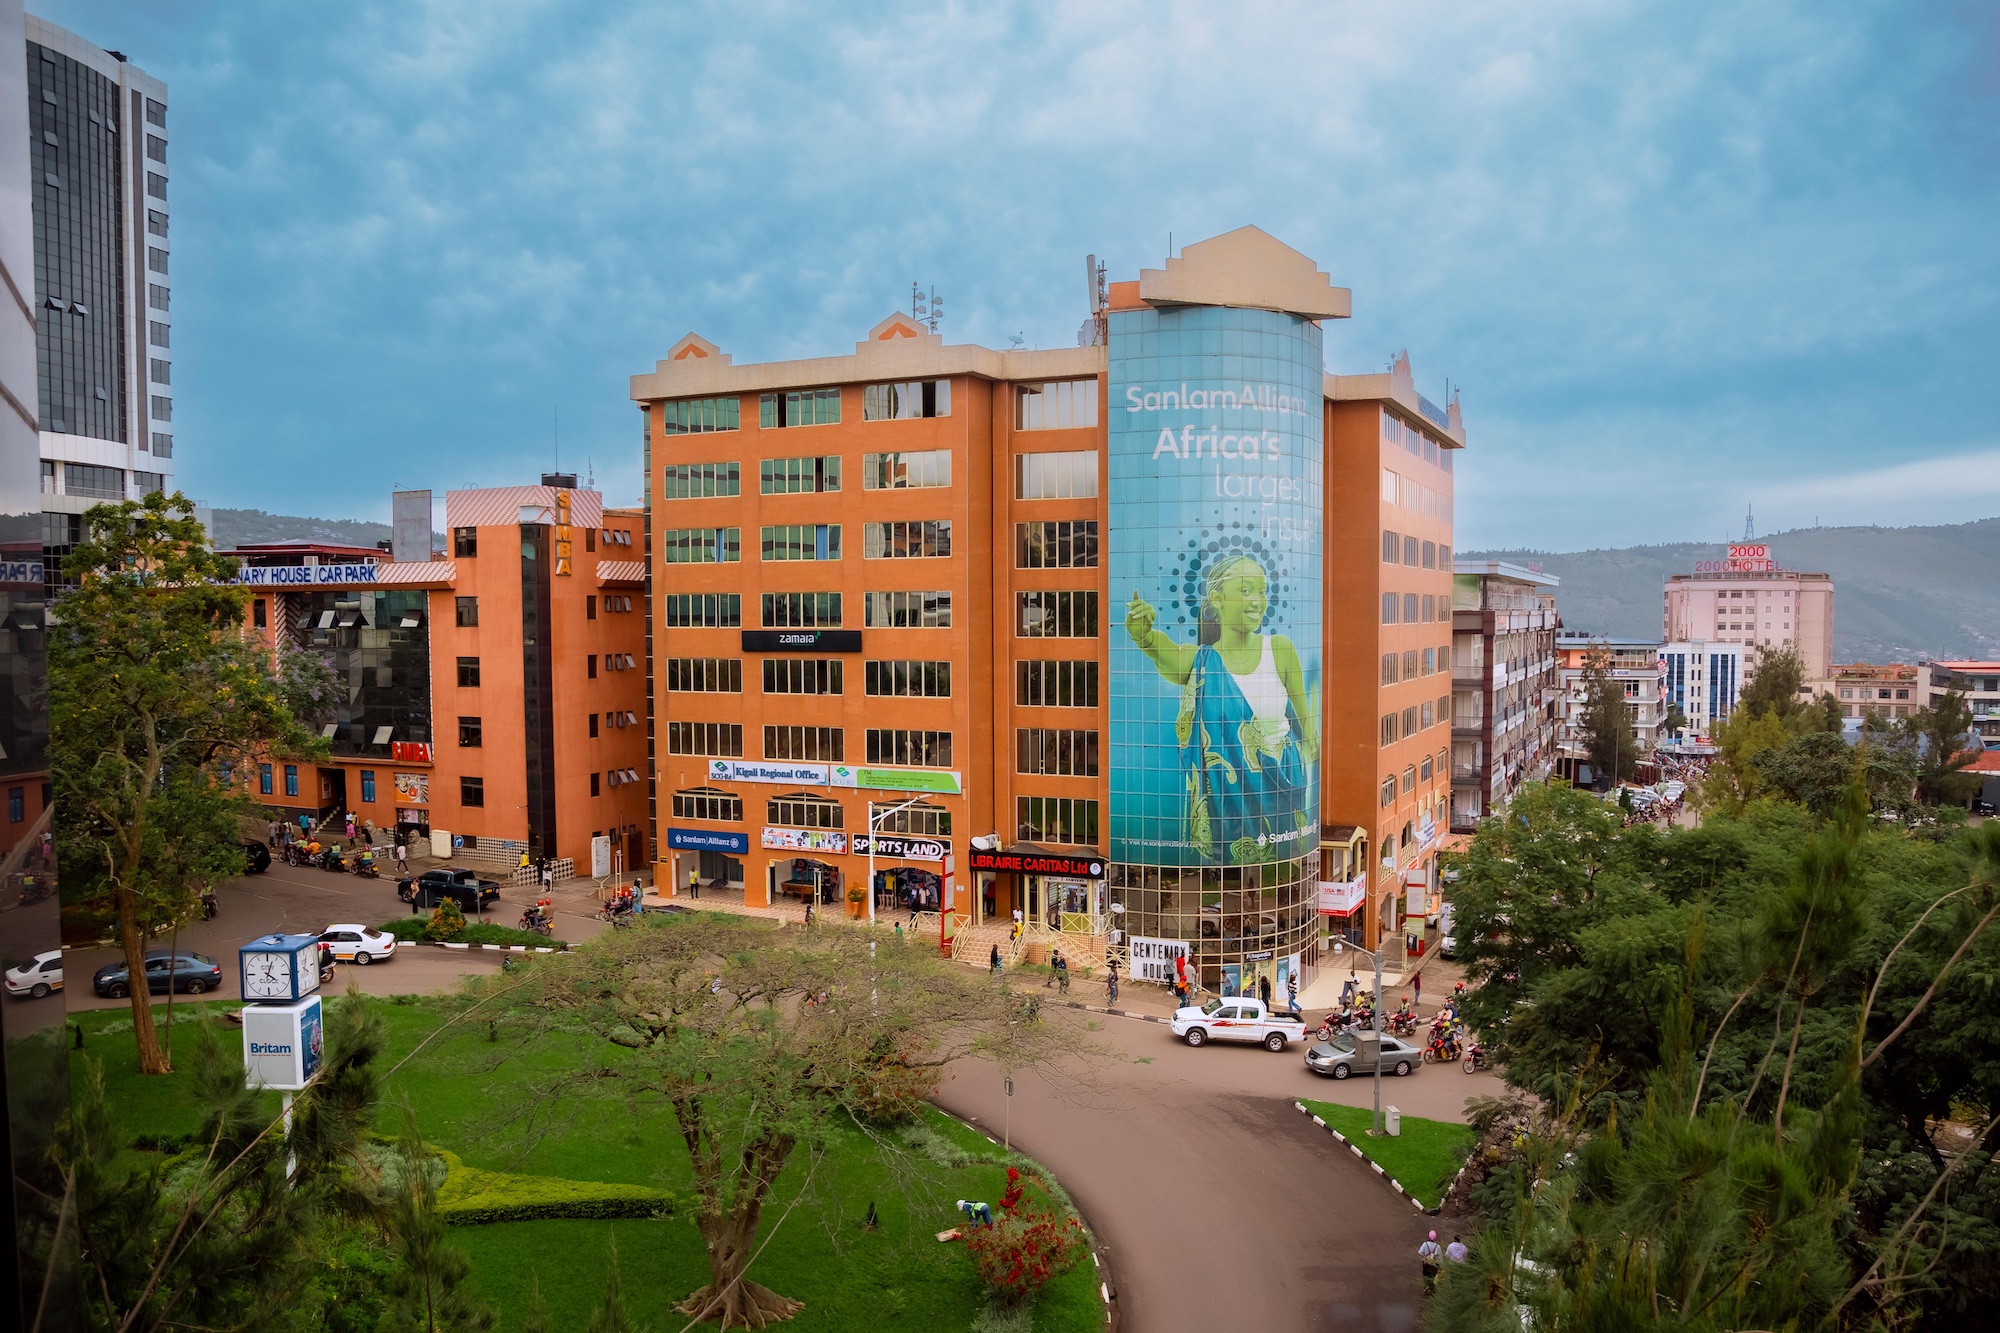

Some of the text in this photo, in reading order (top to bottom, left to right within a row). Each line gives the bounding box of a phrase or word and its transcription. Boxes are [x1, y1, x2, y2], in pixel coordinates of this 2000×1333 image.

[1152, 424, 1281, 462] Africa's
[1215, 463, 1303, 506] larges
[556, 491, 572, 575] SIMBA
[1729, 546, 1765, 557] 2000
[345, 565, 377, 581] PARK
[1695, 560, 1782, 572] 2000 HOTEL
[779, 634, 815, 643] zamara
[392, 742, 431, 762] SIMBA
[735, 767, 819, 780] Kigali Regional Office
[682, 835, 730, 846] Sanlam Allianz
[1269, 830, 1299, 844] Sanlam
[903, 842, 940, 856] LAND
[970, 855, 1088, 874] LIBRAIRIE CARITAS Ltd
[1143, 962, 1168, 980] HOUS
[250, 1042, 292, 1054] Britam
